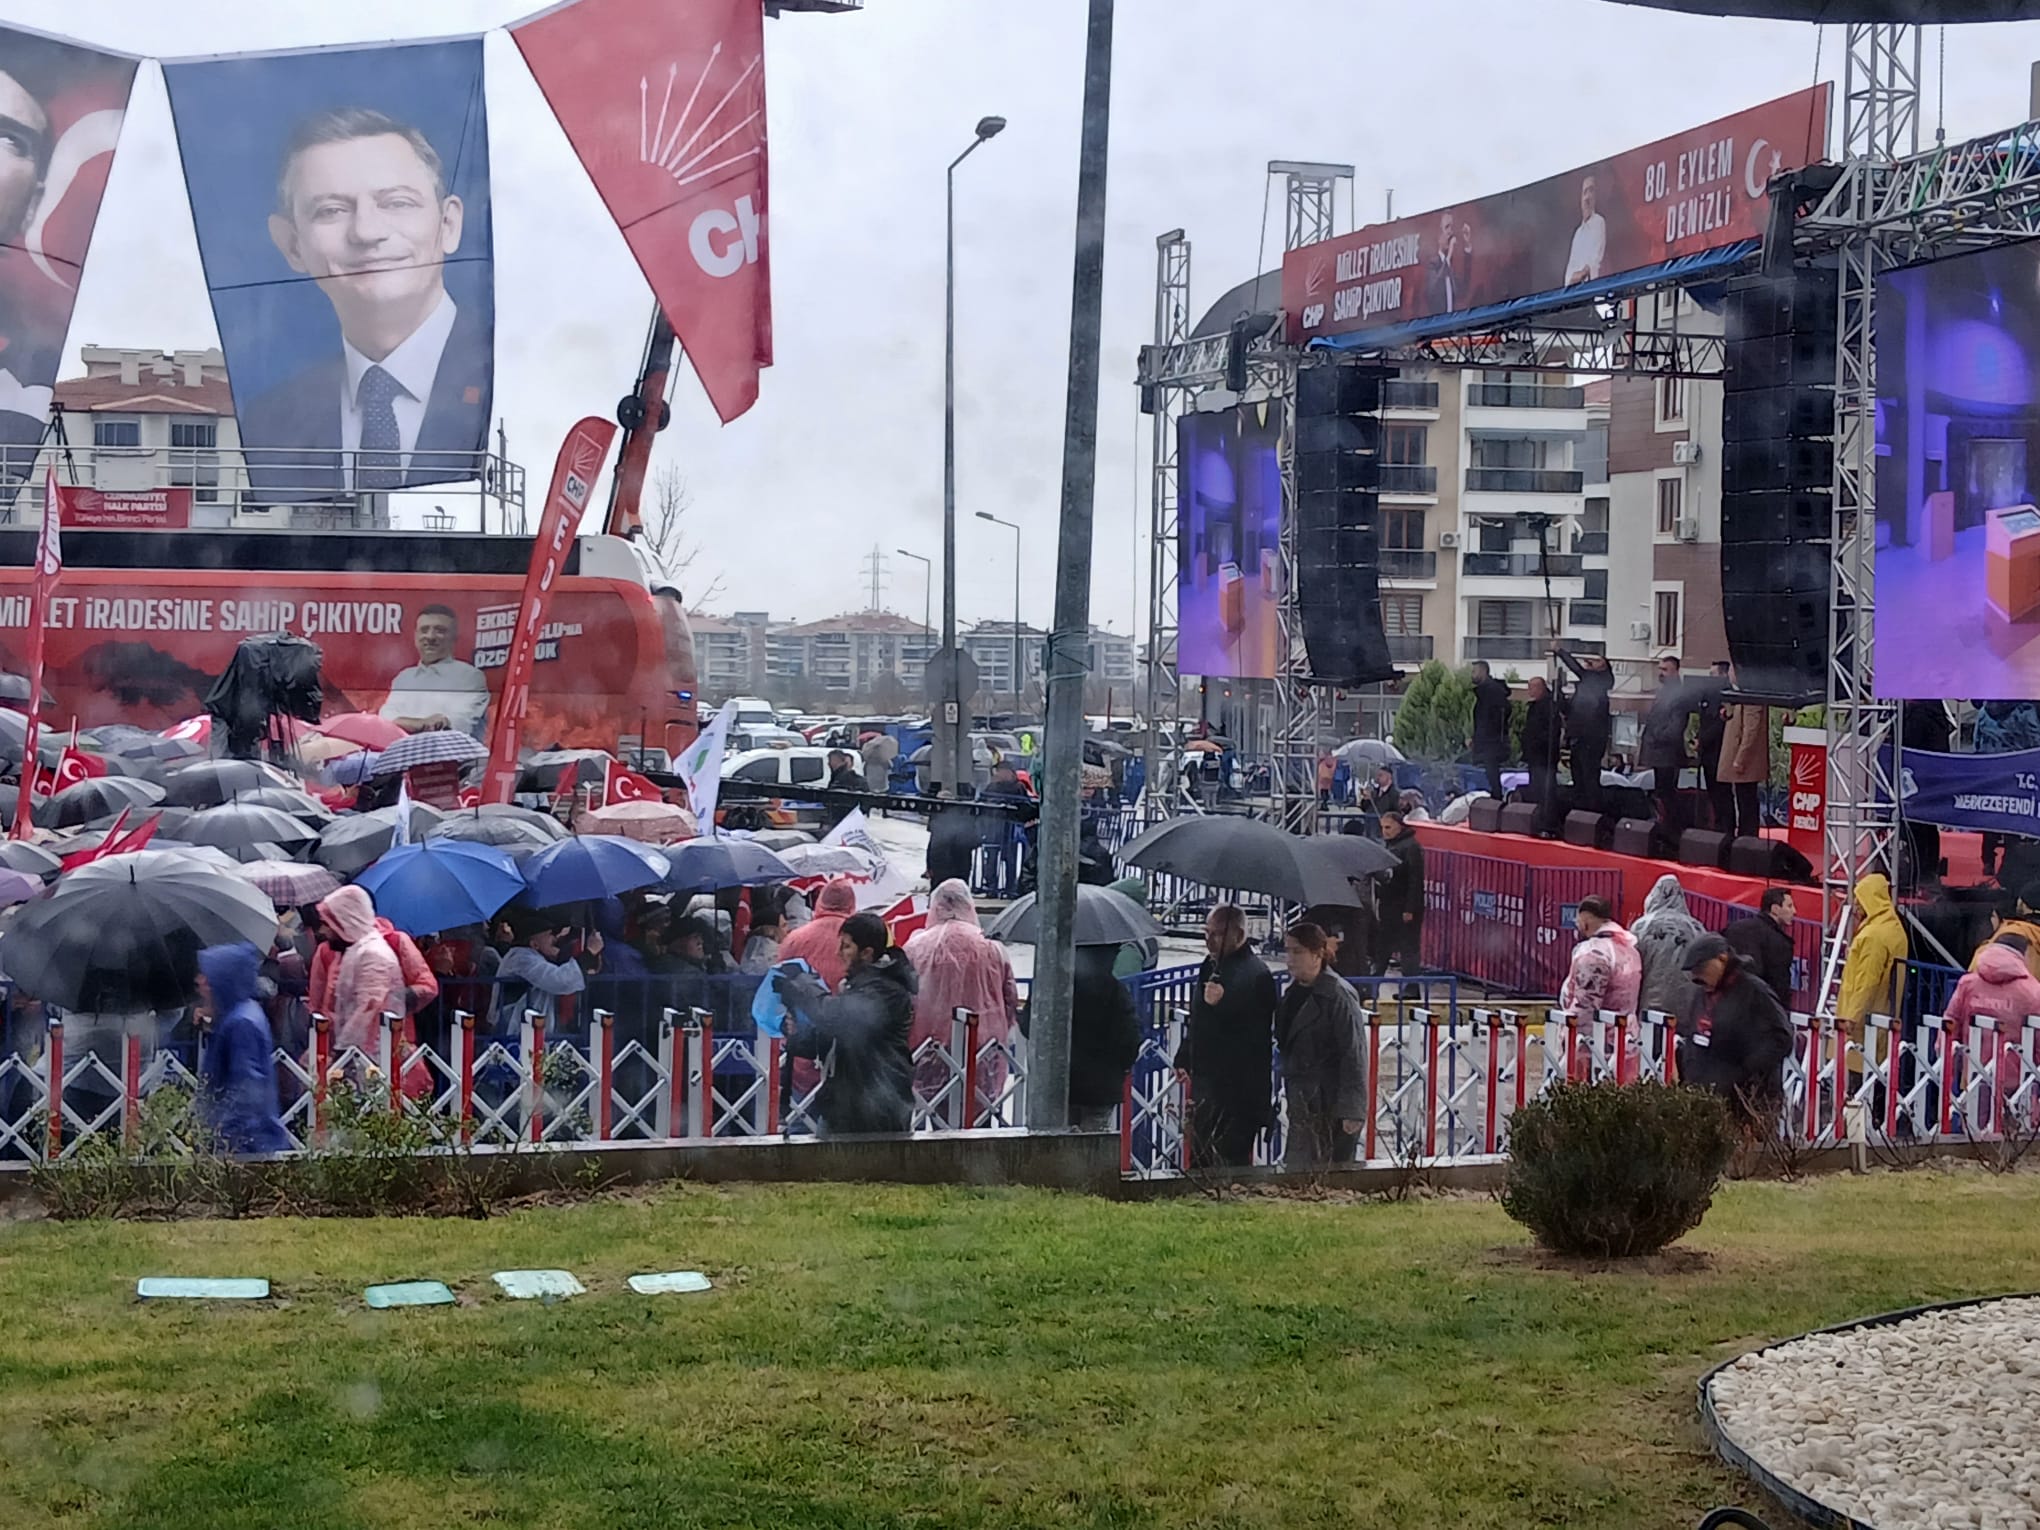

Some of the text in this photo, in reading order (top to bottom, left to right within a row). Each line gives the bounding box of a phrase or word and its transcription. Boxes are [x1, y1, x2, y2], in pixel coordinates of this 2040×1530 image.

[1645, 138, 1733, 202] 80. EYLEM
[1666, 185, 1731, 243] DENİZLİ
[1336, 233, 1420, 283] MİLLET İRADESİNE
[1303, 303, 1325, 329] CHP
[1334, 277, 1402, 321] SAHİP ÇIKIYOR
[0, 595, 402, 638] MİLET İRADESİNE SAHİP ÇIKIYOR
[1792, 791, 1821, 812] CHP
[2015, 773, 2039, 791] T.C.
[1953, 794, 2036, 817] MERKEZEFENDİ
